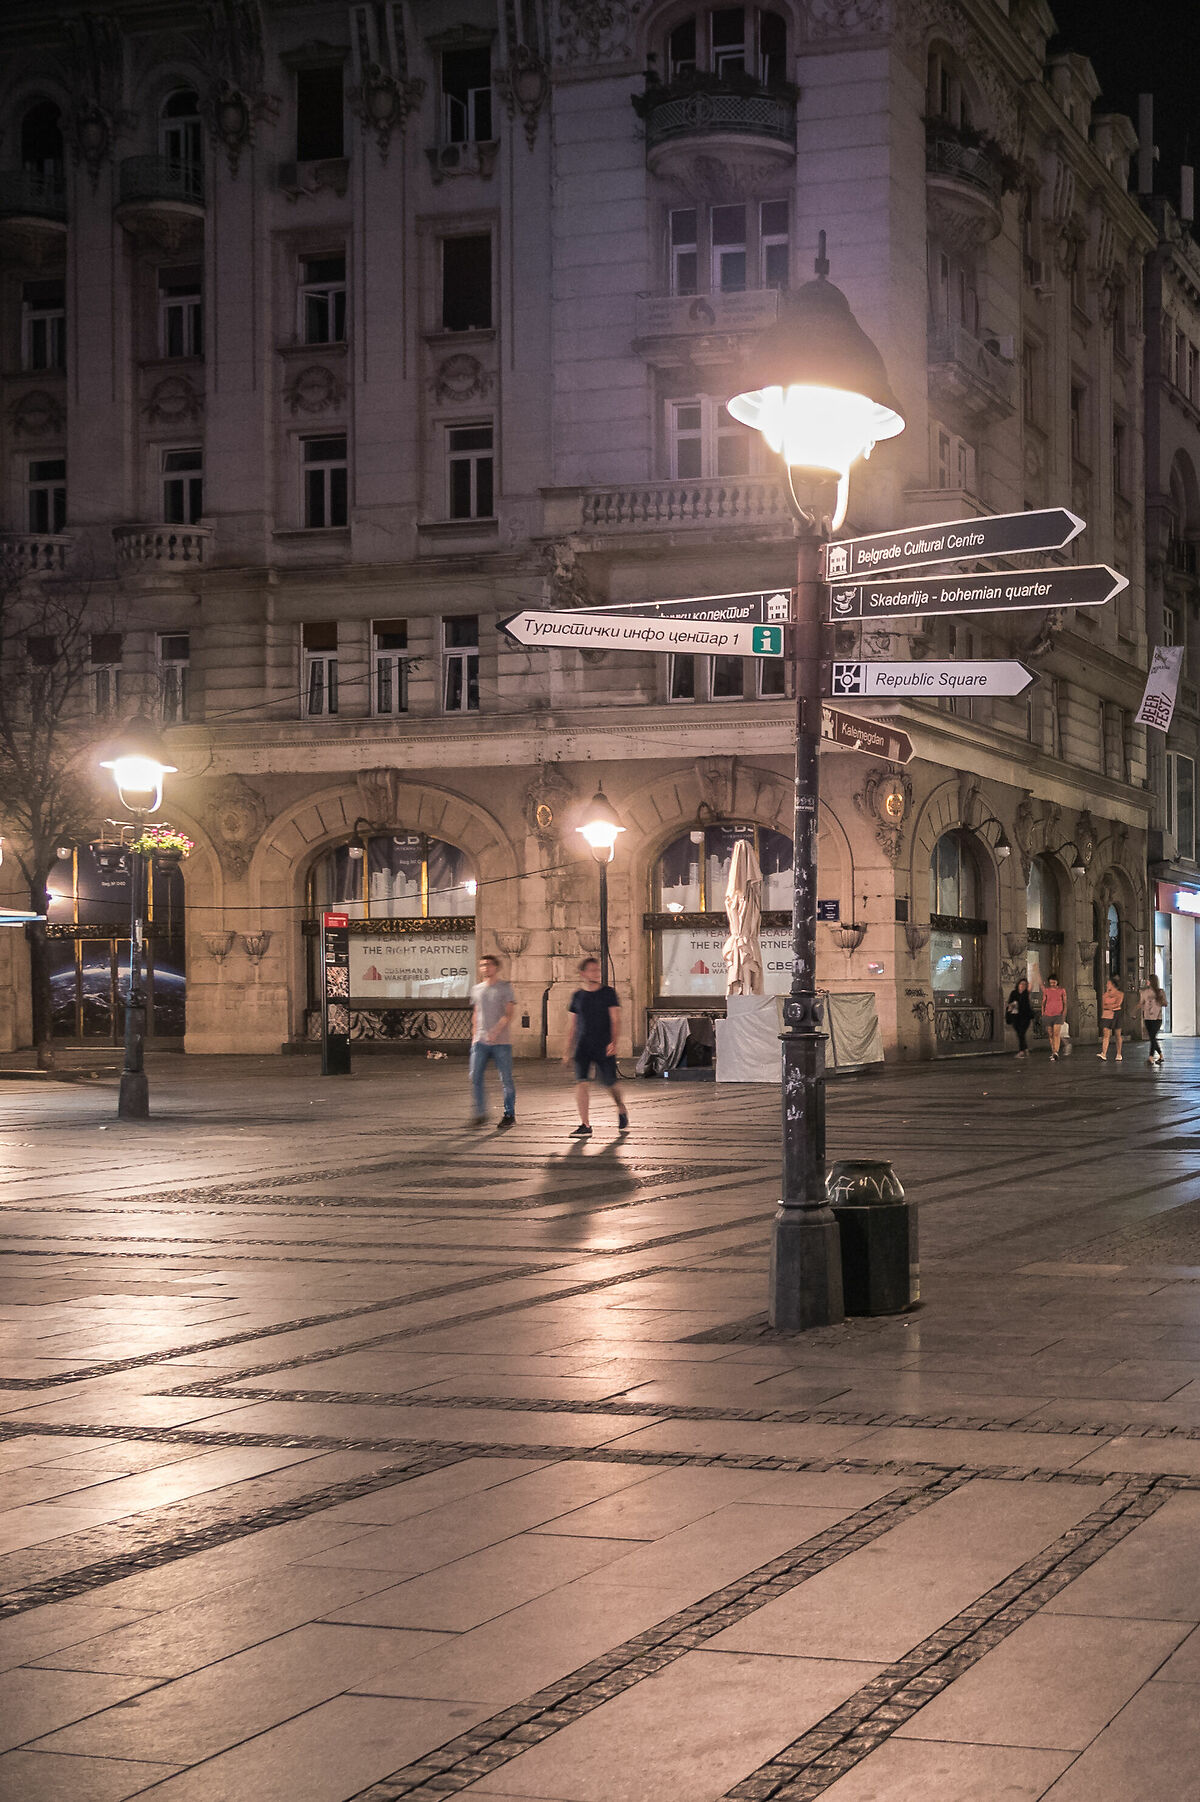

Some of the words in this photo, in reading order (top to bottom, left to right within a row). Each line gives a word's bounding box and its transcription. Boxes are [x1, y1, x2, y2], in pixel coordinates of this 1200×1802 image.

[857, 547, 902, 565] Belgrade
[904, 538, 945, 556] Cultural
[947, 532, 985, 549] Centre
[870, 591, 929, 607] Skadarlija
[940, 587, 1002, 603] bohemian
[1005, 583, 1052, 600] quarter
[623, 627, 665, 642] инфо
[732, 633, 739, 645] 1
[875, 672, 935, 688] Republic
[938, 672, 988, 688] Square
[1141, 694, 1160, 723] BEER
[841, 722, 885, 747] Kalemegdan
[363, 946, 382, 955] THE
[386, 946, 416, 954] RIGHT
[420, 945, 469, 954] PARTNER
[690, 941, 710, 949] THE
[440, 967, 470, 977] CBS
[767, 961, 793, 971] CBS
